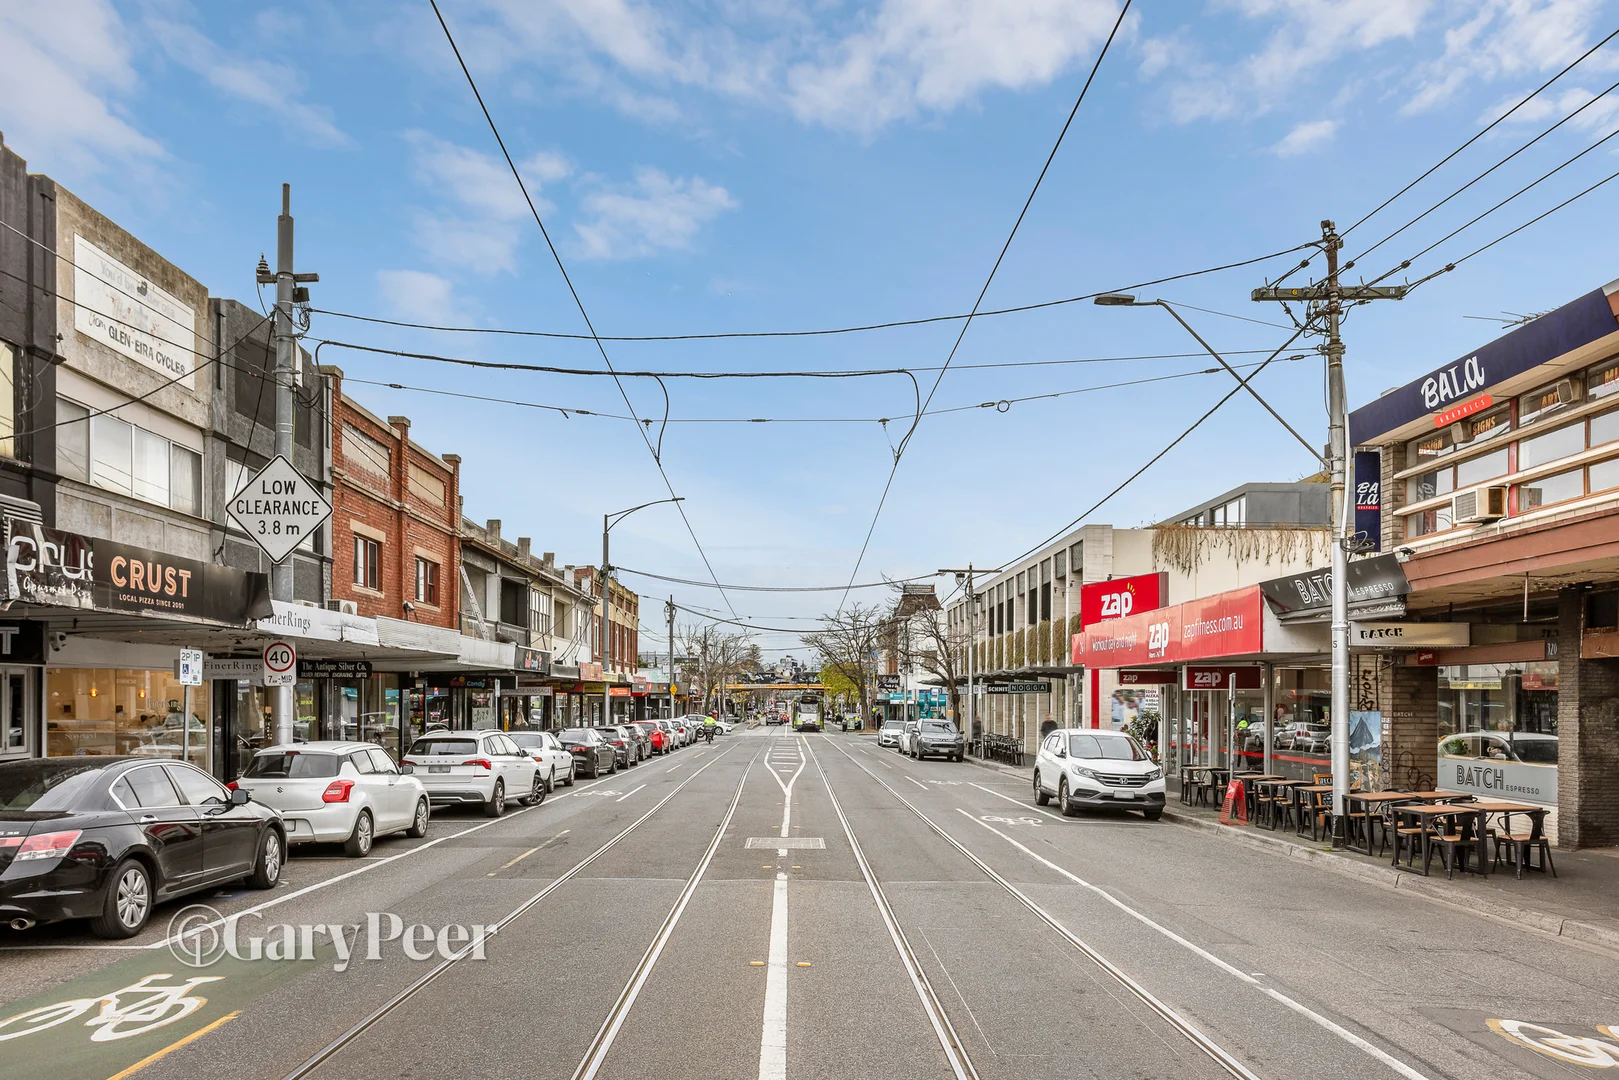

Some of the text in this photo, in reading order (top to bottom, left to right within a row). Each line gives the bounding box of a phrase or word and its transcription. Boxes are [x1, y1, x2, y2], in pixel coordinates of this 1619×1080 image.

[108, 325, 154, 361] GLEN-EIRA
[156, 351, 186, 376] CYCLES
[1439, 398, 1485, 424] GRAPHICS
[1472, 415, 1496, 437] SIGNS
[262, 480, 296, 495] LOW
[1356, 482, 1379, 494] BA
[236, 499, 320, 516] CLEARANCE
[258, 520, 300, 535] 3.8 m
[110, 555, 192, 598] CRUST
[1355, 582, 1394, 596] ESPRESSO
[119, 593, 185, 610] LOCAL PIZZA SINCE 2001
[1101, 591, 1132, 618] zap
[1183, 613, 1243, 642] zapfitness.com.au
[1360, 627, 1404, 640] BATCH
[1148, 621, 1170, 657] zap
[181, 651, 191, 661] 2P
[193, 653, 201, 662] 1P
[269, 650, 290, 664] 40
[302, 662, 367, 672] The Antique Silver Co.
[1122, 674, 1138, 683] zap
[1194, 671, 1222, 687] zap
[1011, 684, 1046, 692] NOGGA
[1456, 764, 1504, 790] BATCH
[1506, 784, 1540, 795] ESPRESSO
